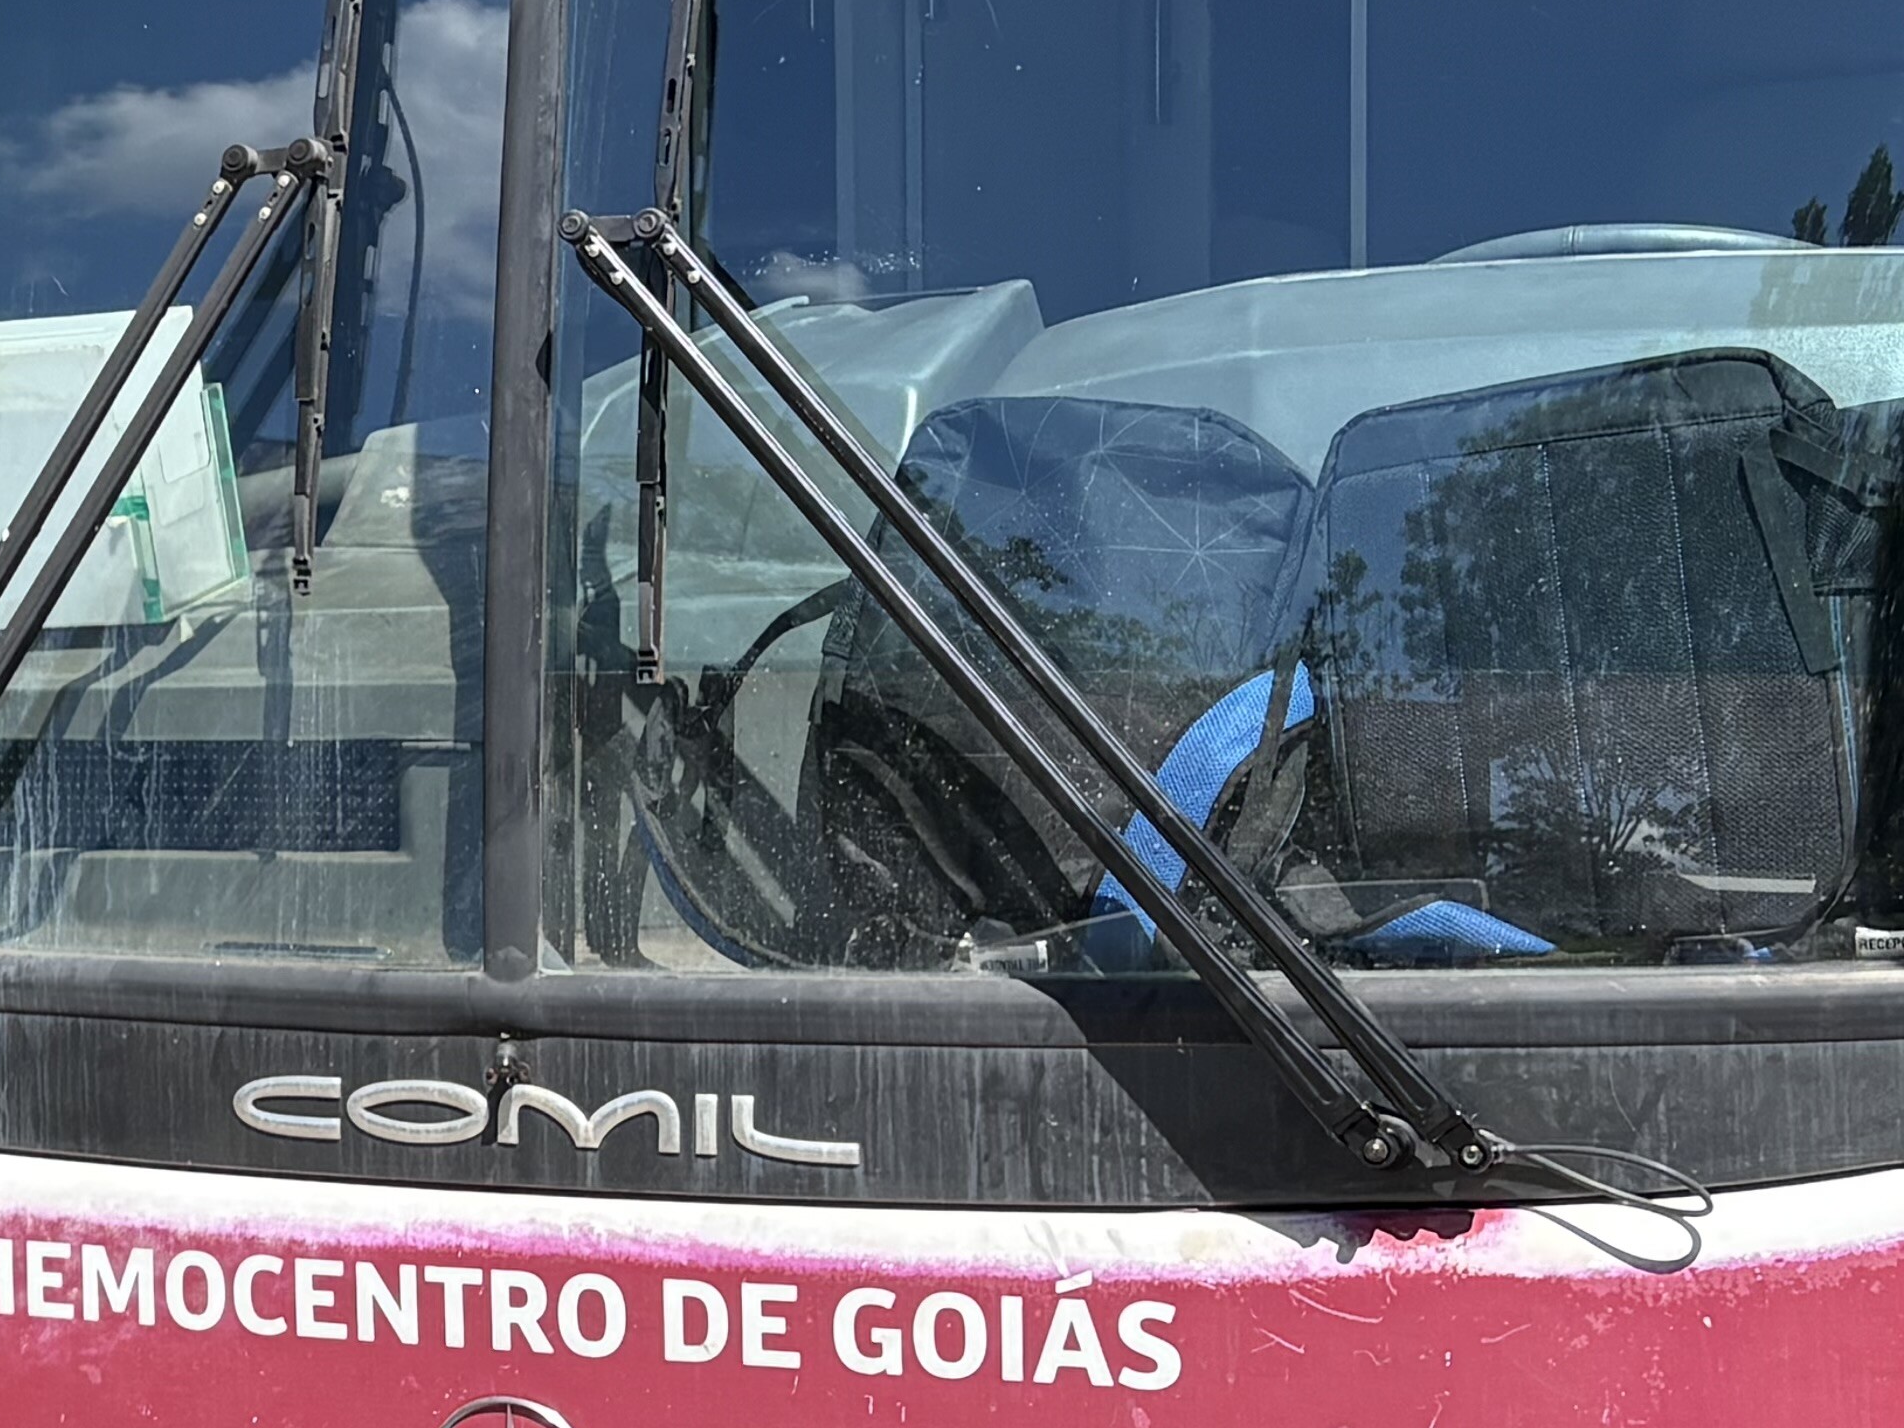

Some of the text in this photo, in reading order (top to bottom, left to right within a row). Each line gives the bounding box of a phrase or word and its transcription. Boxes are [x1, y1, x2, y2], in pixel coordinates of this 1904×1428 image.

[1858, 937, 1904, 950] RECEP
[232, 1075, 860, 1166] COMIL
[662, 1278, 801, 1369] DE
[832, 1271, 1182, 1391] GOIÁS
